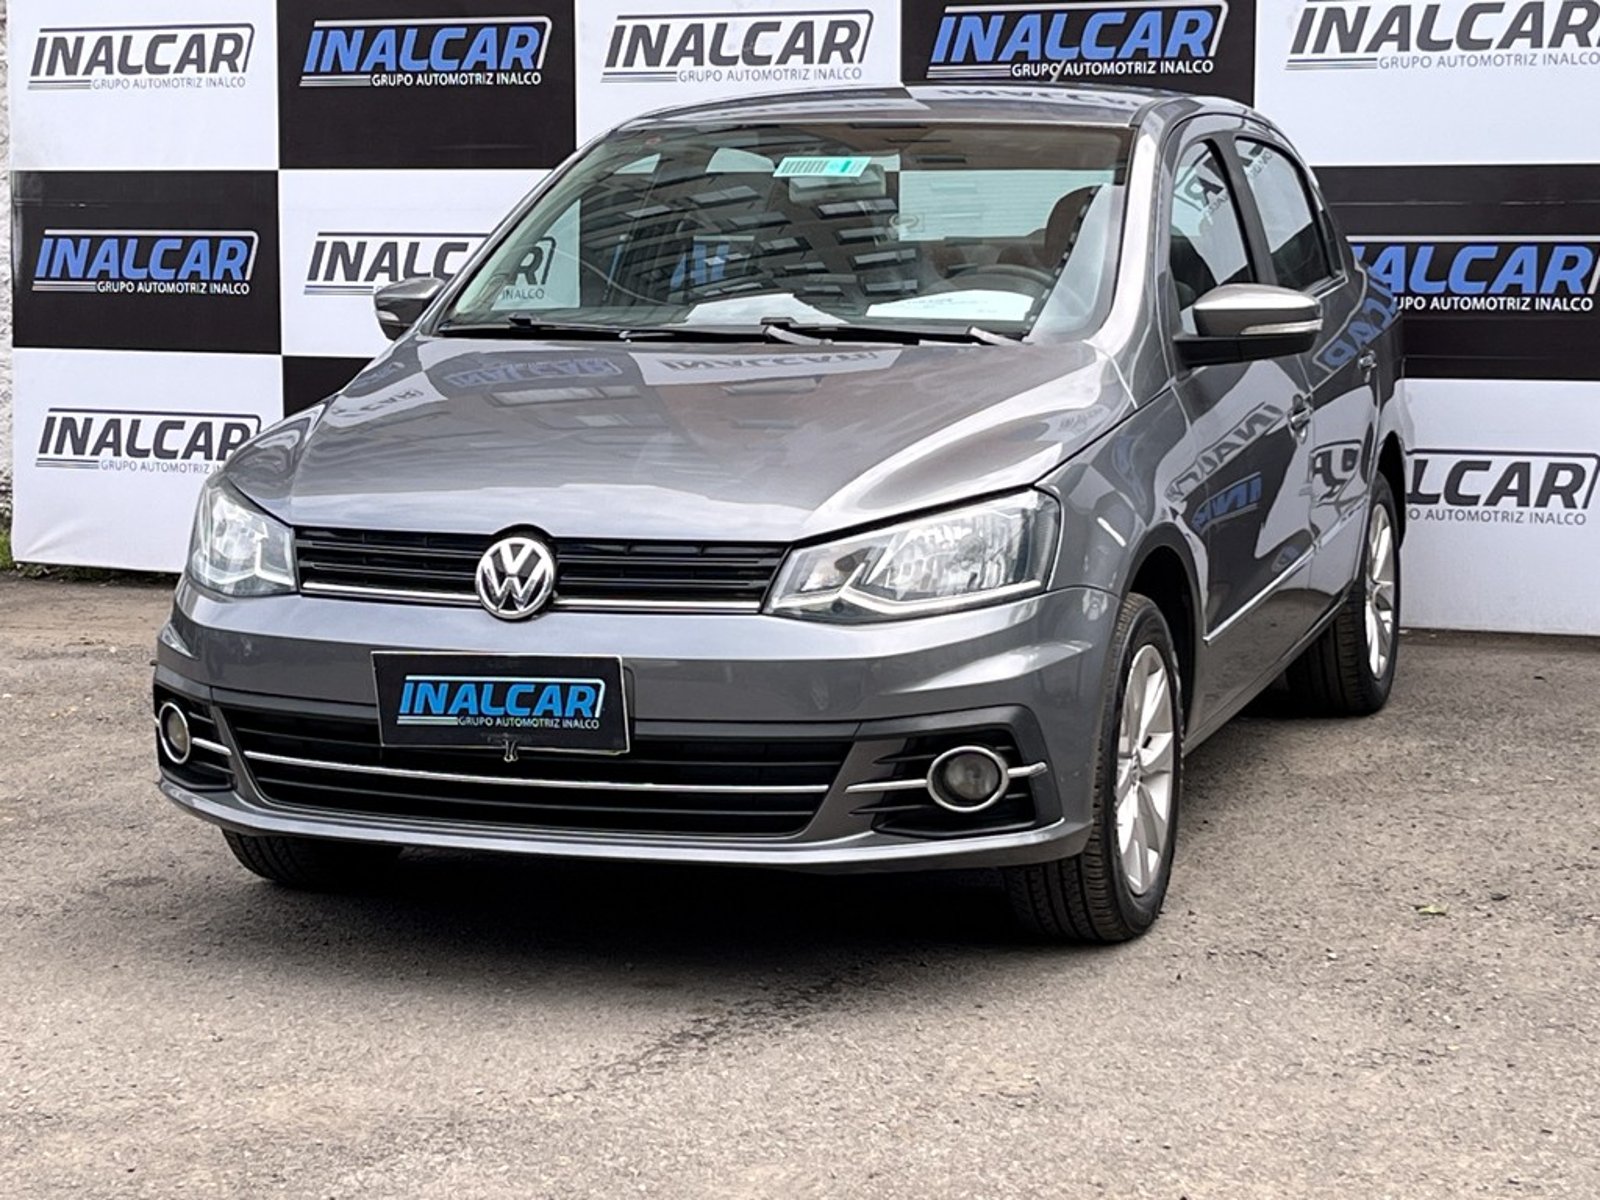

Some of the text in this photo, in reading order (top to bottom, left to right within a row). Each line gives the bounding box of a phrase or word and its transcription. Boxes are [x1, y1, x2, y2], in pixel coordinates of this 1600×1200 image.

[930, 9, 1214, 63] INALCAR
[1289, 1, 1600, 54] INALCAR
[303, 26, 540, 72] INALCAR
[604, 19, 862, 68] INALCAR
[30, 32, 244, 76] INALCAR
[1378, 52, 1600, 70] GRUPO AUTOMOTRIZ INALCO
[678, 67, 862, 82] GRUPO AUTOMOTRIZ INALCO
[1011, 59, 1214, 78] GRUPO AUTOMOTRIZ INALCO
[92, 76, 246, 90] GRUPO AUTOMOTRIZ INALCO
[371, 72, 542, 87] GRUPO AUTOMOTRIZ INALCO
[34, 238, 248, 281] INALCAR
[306, 240, 544, 286] INALCR
[1351, 244, 1594, 295] ALCAR
[96, 281, 250, 295] GRUPO AUTOMOTRIZ INALCO
[502, 288, 545, 300] INALCO
[1394, 296, 1594, 311] UPO AUTOMOTRIZ INALCO
[100, 459, 137, 472] GRUPO
[139, 461, 210, 475] AUTOMOTRIZ
[1406, 458, 1587, 509] LCAR
[1424, 508, 1525, 524] AUTOMOTRIZ
[1529, 512, 1587, 526] INALCO
[399, 682, 597, 718] INALCAR
[458, 715, 600, 730] GRUPO AUTOMOTRIZ INALCO
